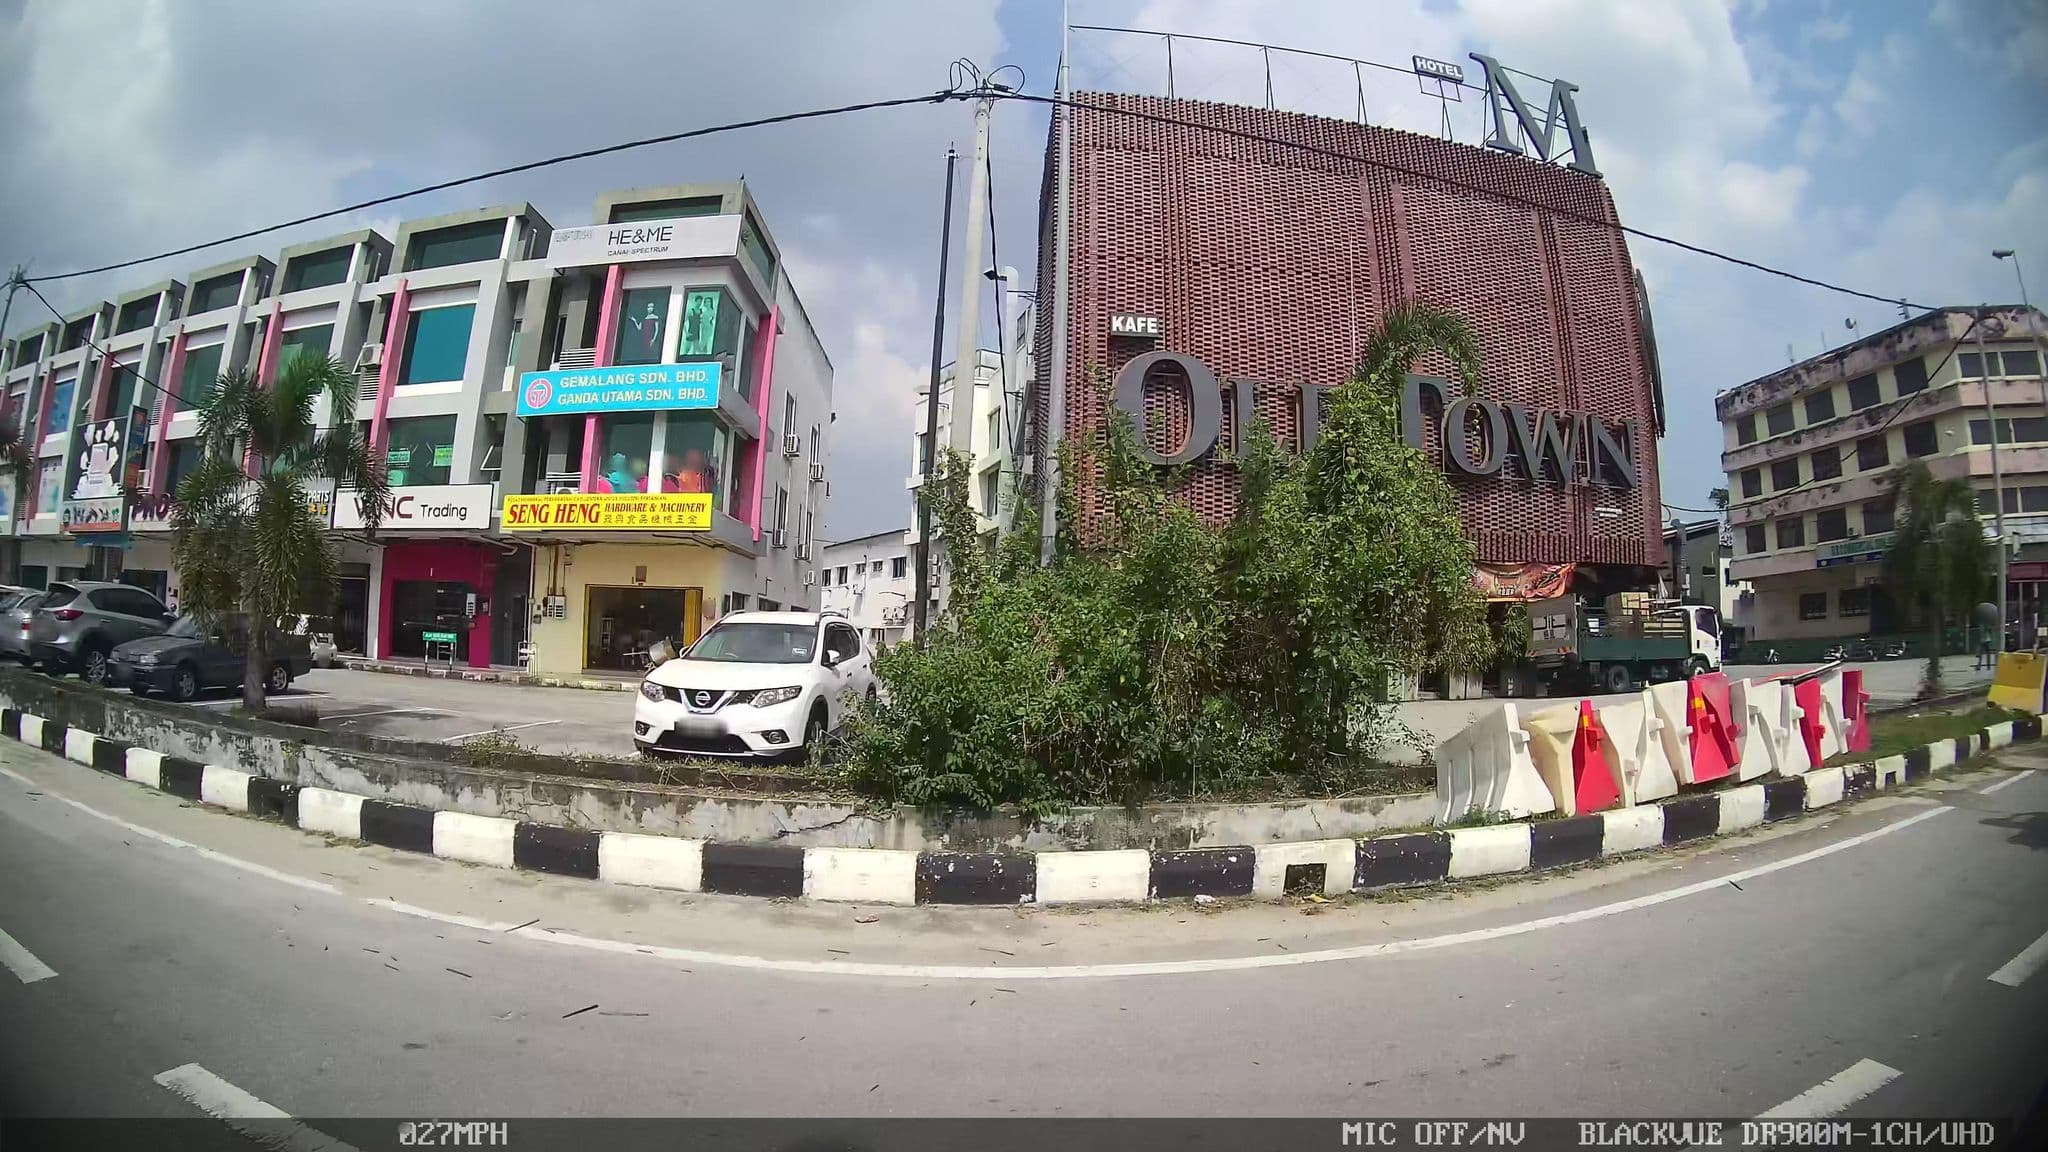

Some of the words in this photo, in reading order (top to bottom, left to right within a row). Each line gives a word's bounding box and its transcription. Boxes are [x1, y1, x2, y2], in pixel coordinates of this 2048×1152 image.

[1415, 57, 1463, 77] HOTEL
[1469, 52, 1603, 179] M
[608, 226, 673, 245] HE&ME
[1112, 316, 1158, 333] KAFE
[559, 372, 635, 388] GEMALANG
[639, 372, 671, 384] SDN.
[676, 370, 709, 383] BHD.
[558, 391, 599, 405] GANDA
[602, 390, 643, 403] UTAMA
[646, 388, 674, 401] SDN.
[678, 388, 708, 400] BHD.
[420, 504, 468, 521] Trading
[507, 504, 550, 523] SENG
[554, 503, 600, 523] HENG
[605, 503, 648, 512] HARDWARE
[649, 503, 656, 512] &
[658, 503, 707, 512] MACHINERY
